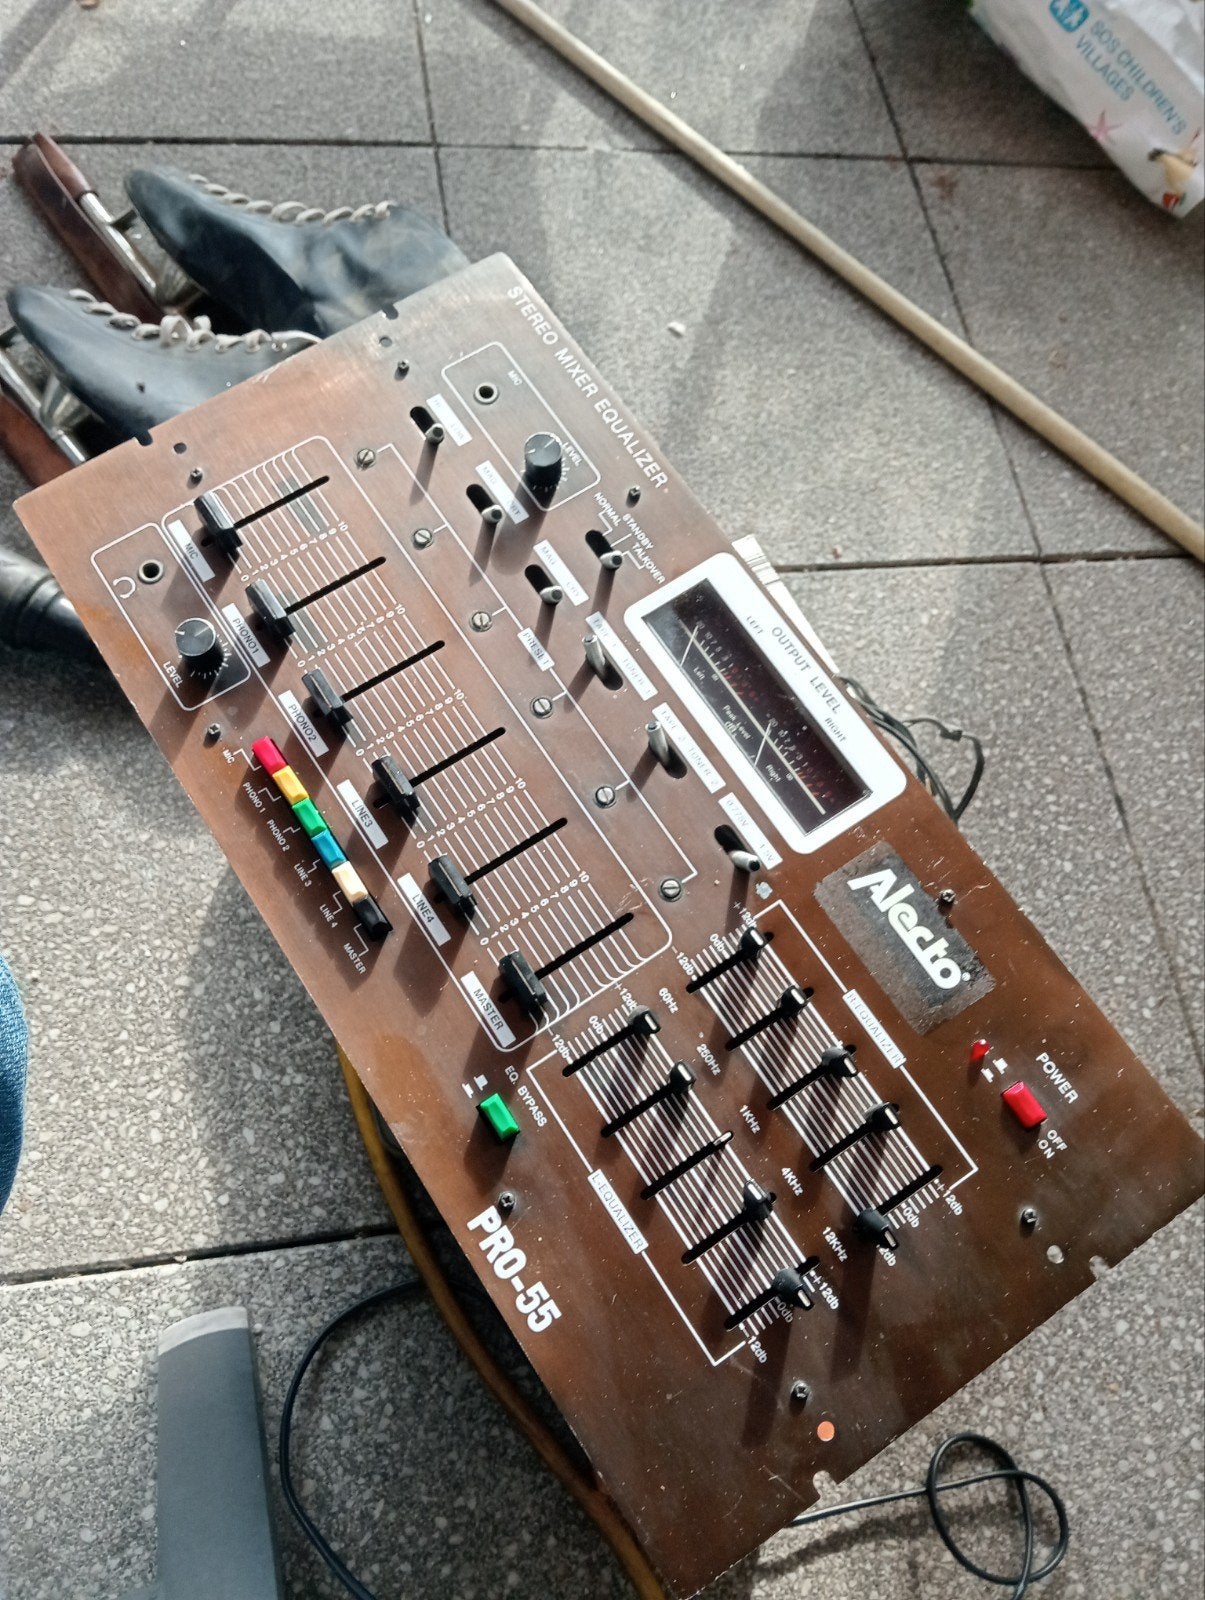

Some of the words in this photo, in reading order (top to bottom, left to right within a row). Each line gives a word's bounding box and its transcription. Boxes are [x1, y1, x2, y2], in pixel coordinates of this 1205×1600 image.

[1076, 35, 1135, 101] VILLAGES
[1091, 20, 1119, 54] SOS
[1117, 51, 1186, 135] CHILDREN'S
[507, 370, 522, 386] MIC
[507, 286, 559, 345] STEREO
[555, 348, 599, 399] MIXER
[594, 398, 668, 489] EQUALIZER
[562, 442, 582, 466] LEVEL
[594, 493, 622, 527] NORMAL
[622, 513, 654, 550] STANDBY
[184, 543, 200, 561] MIC
[240, 574, 249, 582] 0
[260, 563, 269, 571] 2
[269, 558, 279, 567] 3
[279, 553, 289, 561] 4
[289, 547, 299, 555] 5
[299, 542, 308, 551] 6
[309, 538, 317, 546] 7
[318, 533, 327, 541] 8
[328, 527, 337, 535] 9
[338, 520, 348, 532] 10
[632, 543, 666, 584] TALKOVER
[232, 617, 260, 654] PHONO1
[297, 659, 306, 668] 0
[317, 648, 326, 657] 2
[326, 643, 336, 651] 3
[336, 638, 346, 646] 4
[347, 632, 356, 640] 5
[356, 626, 366, 634] 6
[376, 615, 385, 624] 8
[385, 610, 395, 619] 9
[395, 603, 405, 615] 10
[746, 616, 764, 634] LEFT
[523, 632, 550, 665] PRESET
[162, 661, 184, 688] LEVEL
[692, 666, 706, 681] Left
[771, 626, 810, 672] OUTPUT
[810, 676, 841, 714] LEVEL
[288, 704, 317, 742] PHONO2
[355, 748, 365, 757] 0
[376, 736, 385, 745] 2
[385, 731, 395, 739] 3
[396, 725, 405, 733] 4
[405, 719, 415, 727] 5
[415, 714, 424, 722] 6
[434, 702, 444, 711] 8
[444, 696, 453, 705] 9
[454, 688, 464, 700] 10
[722, 703, 737, 721] Peak
[734, 720, 751, 740] Level
[824, 718, 847, 742] RIGHT
[222, 749, 235, 764] MIC
[764, 762, 782, 783] Right
[242, 782, 261, 807] PHONO
[351, 799, 373, 828] LINE3
[416, 840, 425, 849] 0
[437, 828, 446, 837] 2
[446, 822, 456, 830] 3
[456, 816, 466, 825] 4
[466, 810, 476, 818] 5
[476, 804, 486, 812] 6
[496, 791, 505, 800] 8
[506, 785, 515, 794] 9
[515, 777, 526, 789] 10
[267, 819, 285, 845] PHONO
[294, 863, 307, 881] LINE
[319, 904, 333, 921] LINE
[411, 893, 434, 923] LINE4
[480, 937, 489, 946] 0
[500, 924, 509, 933] 2
[510, 918, 519, 926] 3
[520, 911, 530, 919] 4
[530, 904, 540, 913] 5
[540, 898, 549, 906] 6
[550, 891, 559, 899] 7
[560, 885, 569, 893] 8
[569, 879, 578, 888] 9
[579, 871, 589, 883] 10
[847, 868, 962, 989] Alecto
[344, 943, 367, 975] MASTER
[473, 988, 504, 1031] MASTER
[658, 987, 680, 1014] 60Hz
[589, 1015, 604, 1034] 0db
[696, 1044, 721, 1075] 250Hz
[1036, 1052, 1079, 1104] POWER
[517, 1085, 548, 1127] BYPASS
[740, 1105, 761, 1134] 1KHz
[1038, 1139, 1055, 1159] ON
[1047, 1130, 1068, 1151] OFF
[781, 1167, 803, 1196] 4KHz
[822, 1227, 848, 1262] 12KHz
[467, 1205, 562, 1333] PRO-55
[813, 1273, 840, 1310] +12db
